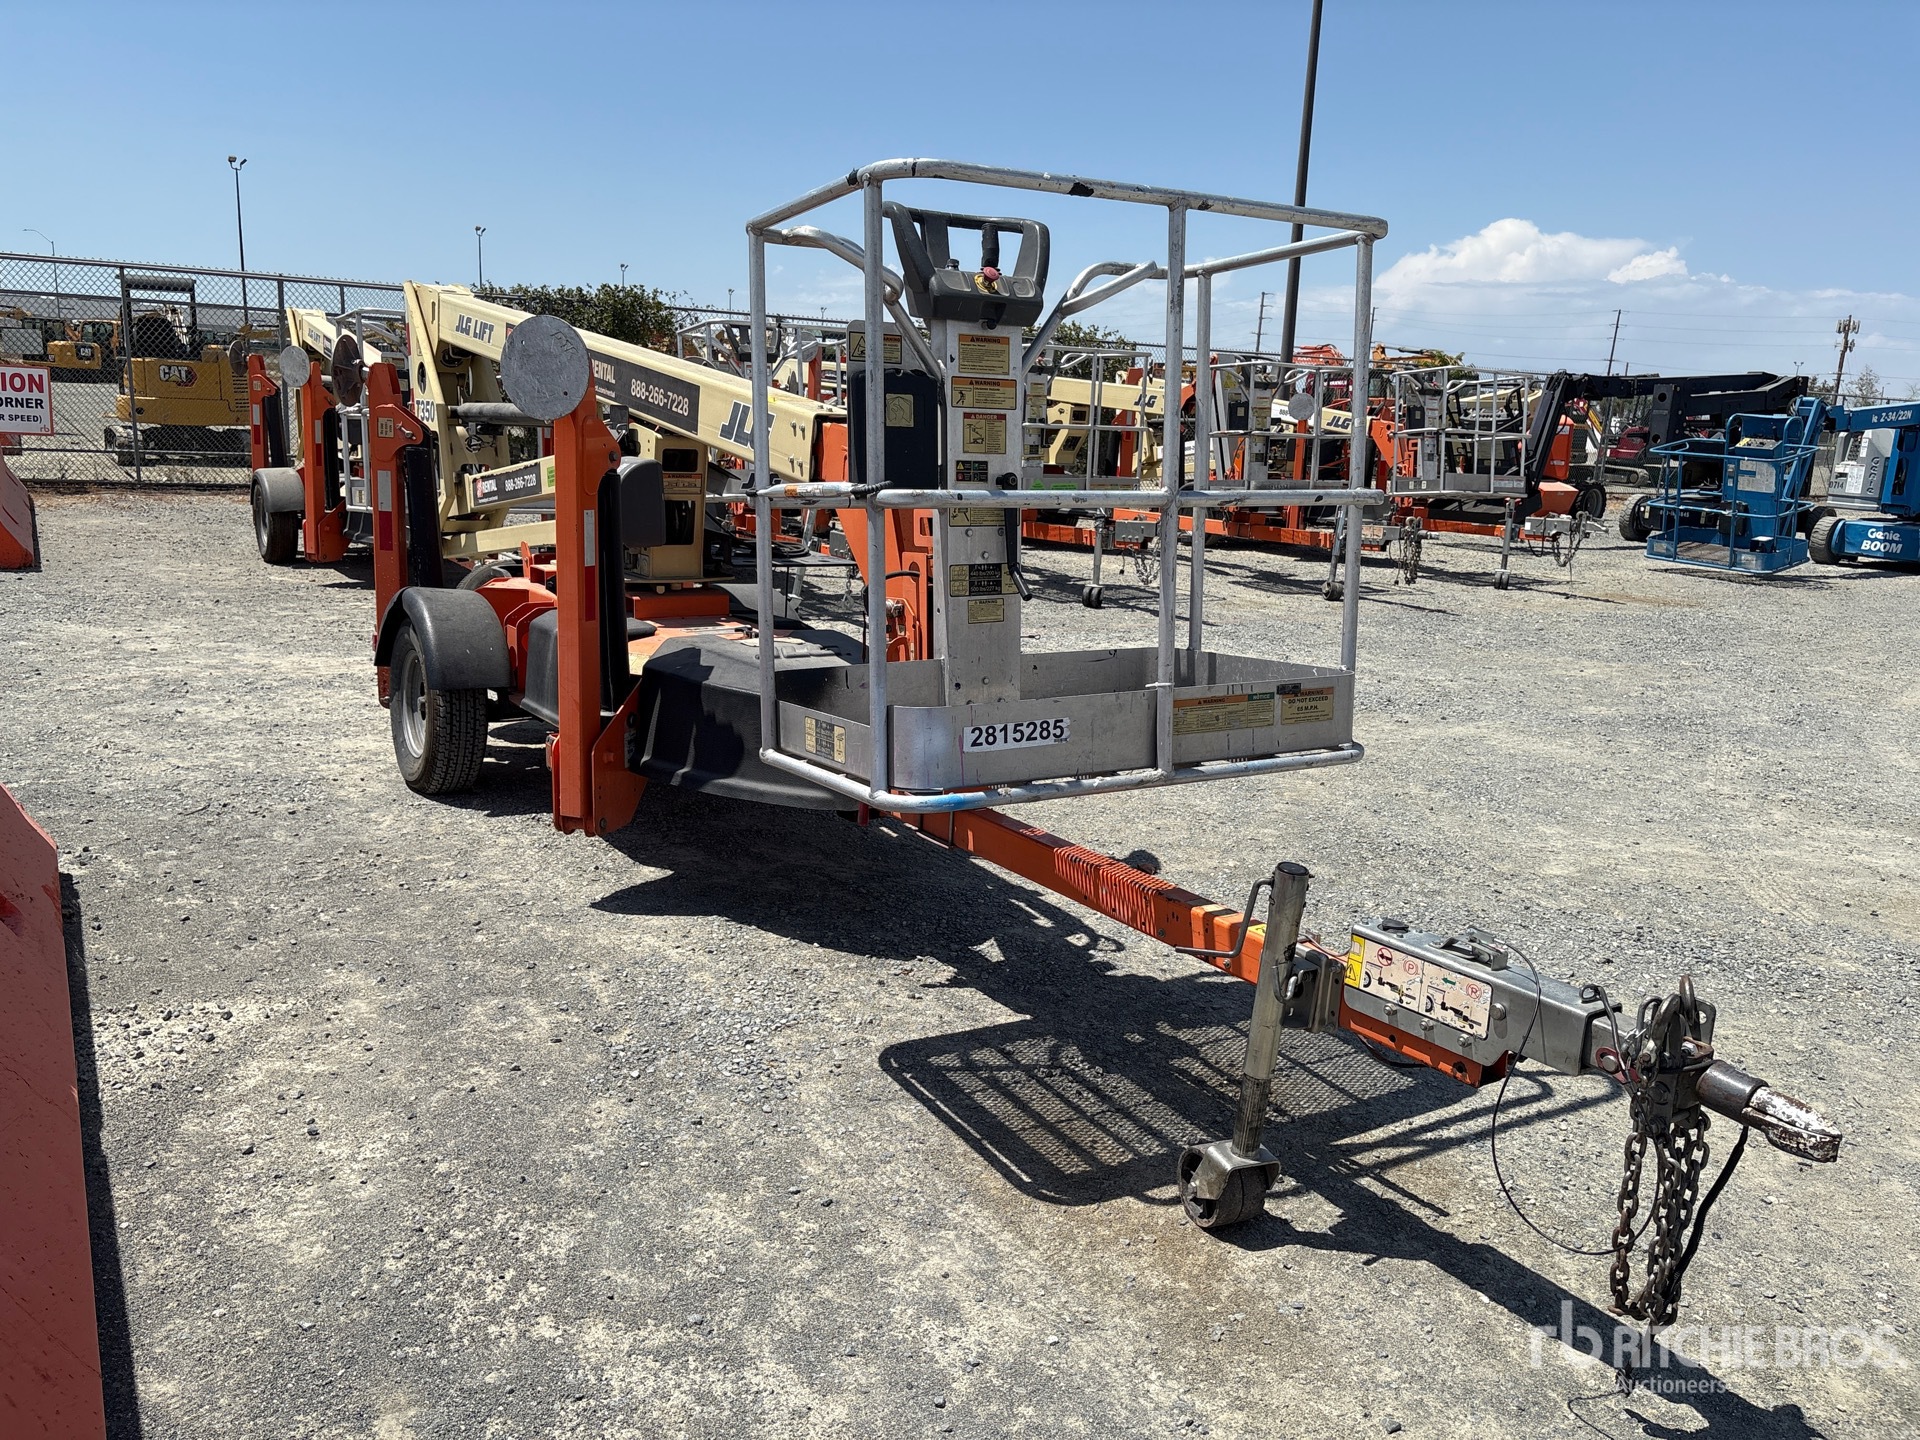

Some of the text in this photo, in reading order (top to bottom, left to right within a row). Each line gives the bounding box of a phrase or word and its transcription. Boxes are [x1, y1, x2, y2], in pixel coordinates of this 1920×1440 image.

[455, 314, 495, 344] JLG LIFT
[80, 347, 92, 357] CAT
[159, 364, 188, 382] CAT
[630, 378, 690, 417] 888-266-7228
[1133, 393, 1158, 408] JG
[416, 399, 435, 422] T350
[1880, 410, 1913, 423] Z-34/22N
[8, 413, 43, 424] SPEED)
[1326, 415, 1352, 430] JLG
[1866, 456, 1880, 495] Genie
[1867, 528, 1901, 541] Genie
[1861, 539, 1903, 554] BOOM
[1308, 695, 1329, 703] EXCEED
[970, 718, 1066, 748] 2815285
